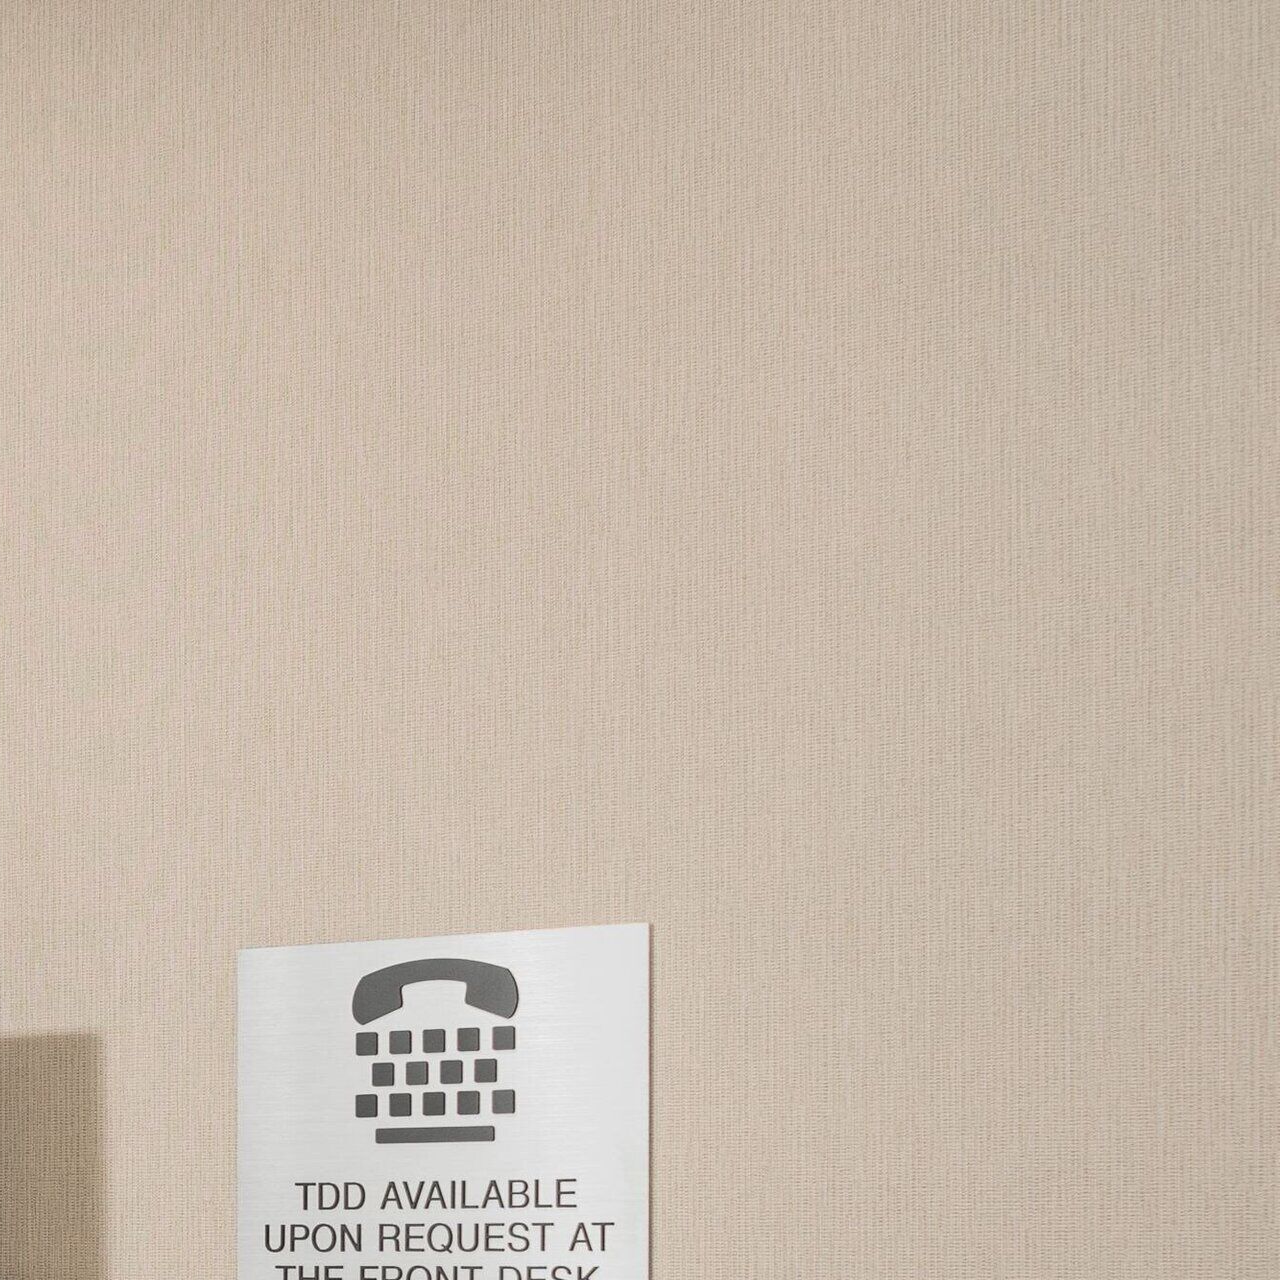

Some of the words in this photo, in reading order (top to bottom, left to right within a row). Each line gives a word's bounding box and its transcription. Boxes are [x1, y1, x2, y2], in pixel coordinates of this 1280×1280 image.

[295, 1181, 366, 1211] TDD
[380, 1178, 578, 1210] AVAILABLE
[264, 1223, 362, 1253] UPON
[378, 1222, 555, 1254] REQUEST
[569, 1221, 615, 1252] AT
